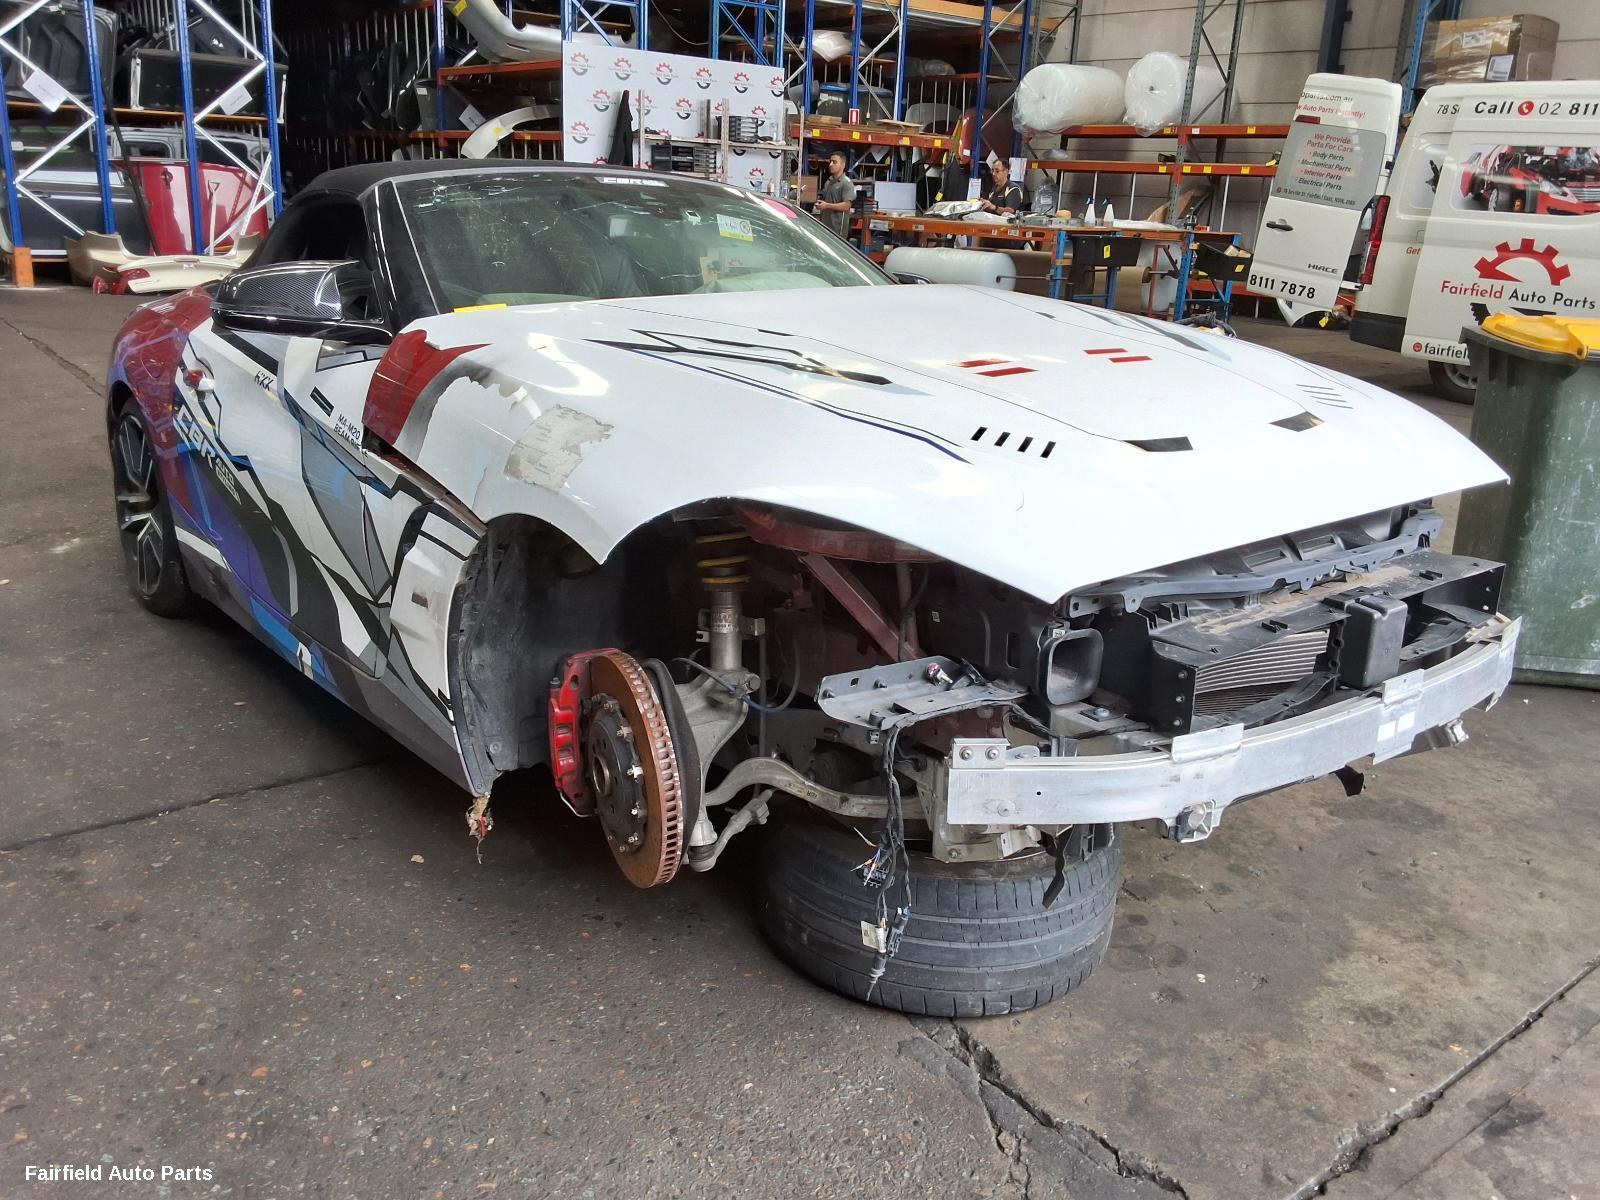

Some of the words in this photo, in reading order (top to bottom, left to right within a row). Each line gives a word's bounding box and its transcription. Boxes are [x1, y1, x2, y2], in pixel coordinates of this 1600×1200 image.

[1303, 104, 1317, 112] Auto
[1436, 104, 1449, 115] 78
[1474, 101, 1514, 115] Call
[1538, 103, 1562, 115] 02
[1568, 103, 1599, 115] 811
[1306, 140, 1323, 149] Parts
[1325, 142, 1337, 150] For
[1338, 145, 1354, 153] Cars
[1326, 135, 1351, 145] Provide
[1312, 151, 1328, 160] Body
[1301, 159, 1335, 169] Mechanical
[1335, 164, 1352, 172] Parts
[1303, 169, 1325, 177] Interior
[1326, 172, 1342, 180] Parts
[1298, 178, 1326, 187] Electrical
[1326, 182, 1342, 191] Parts
[1406, 247, 1421, 255] Get
[1307, 263, 1338, 274] HIACE
[1249, 274, 1275, 290] 8111
[1280, 281, 1316, 299] 7878
[1440, 280, 1504, 299] Fairfield
[1508, 288, 1546, 304] Auto
[1552, 292, 1596, 310] Parts
[1424, 342, 1469, 360] fairfiel
[337, 413, 361, 440] MA-M20
